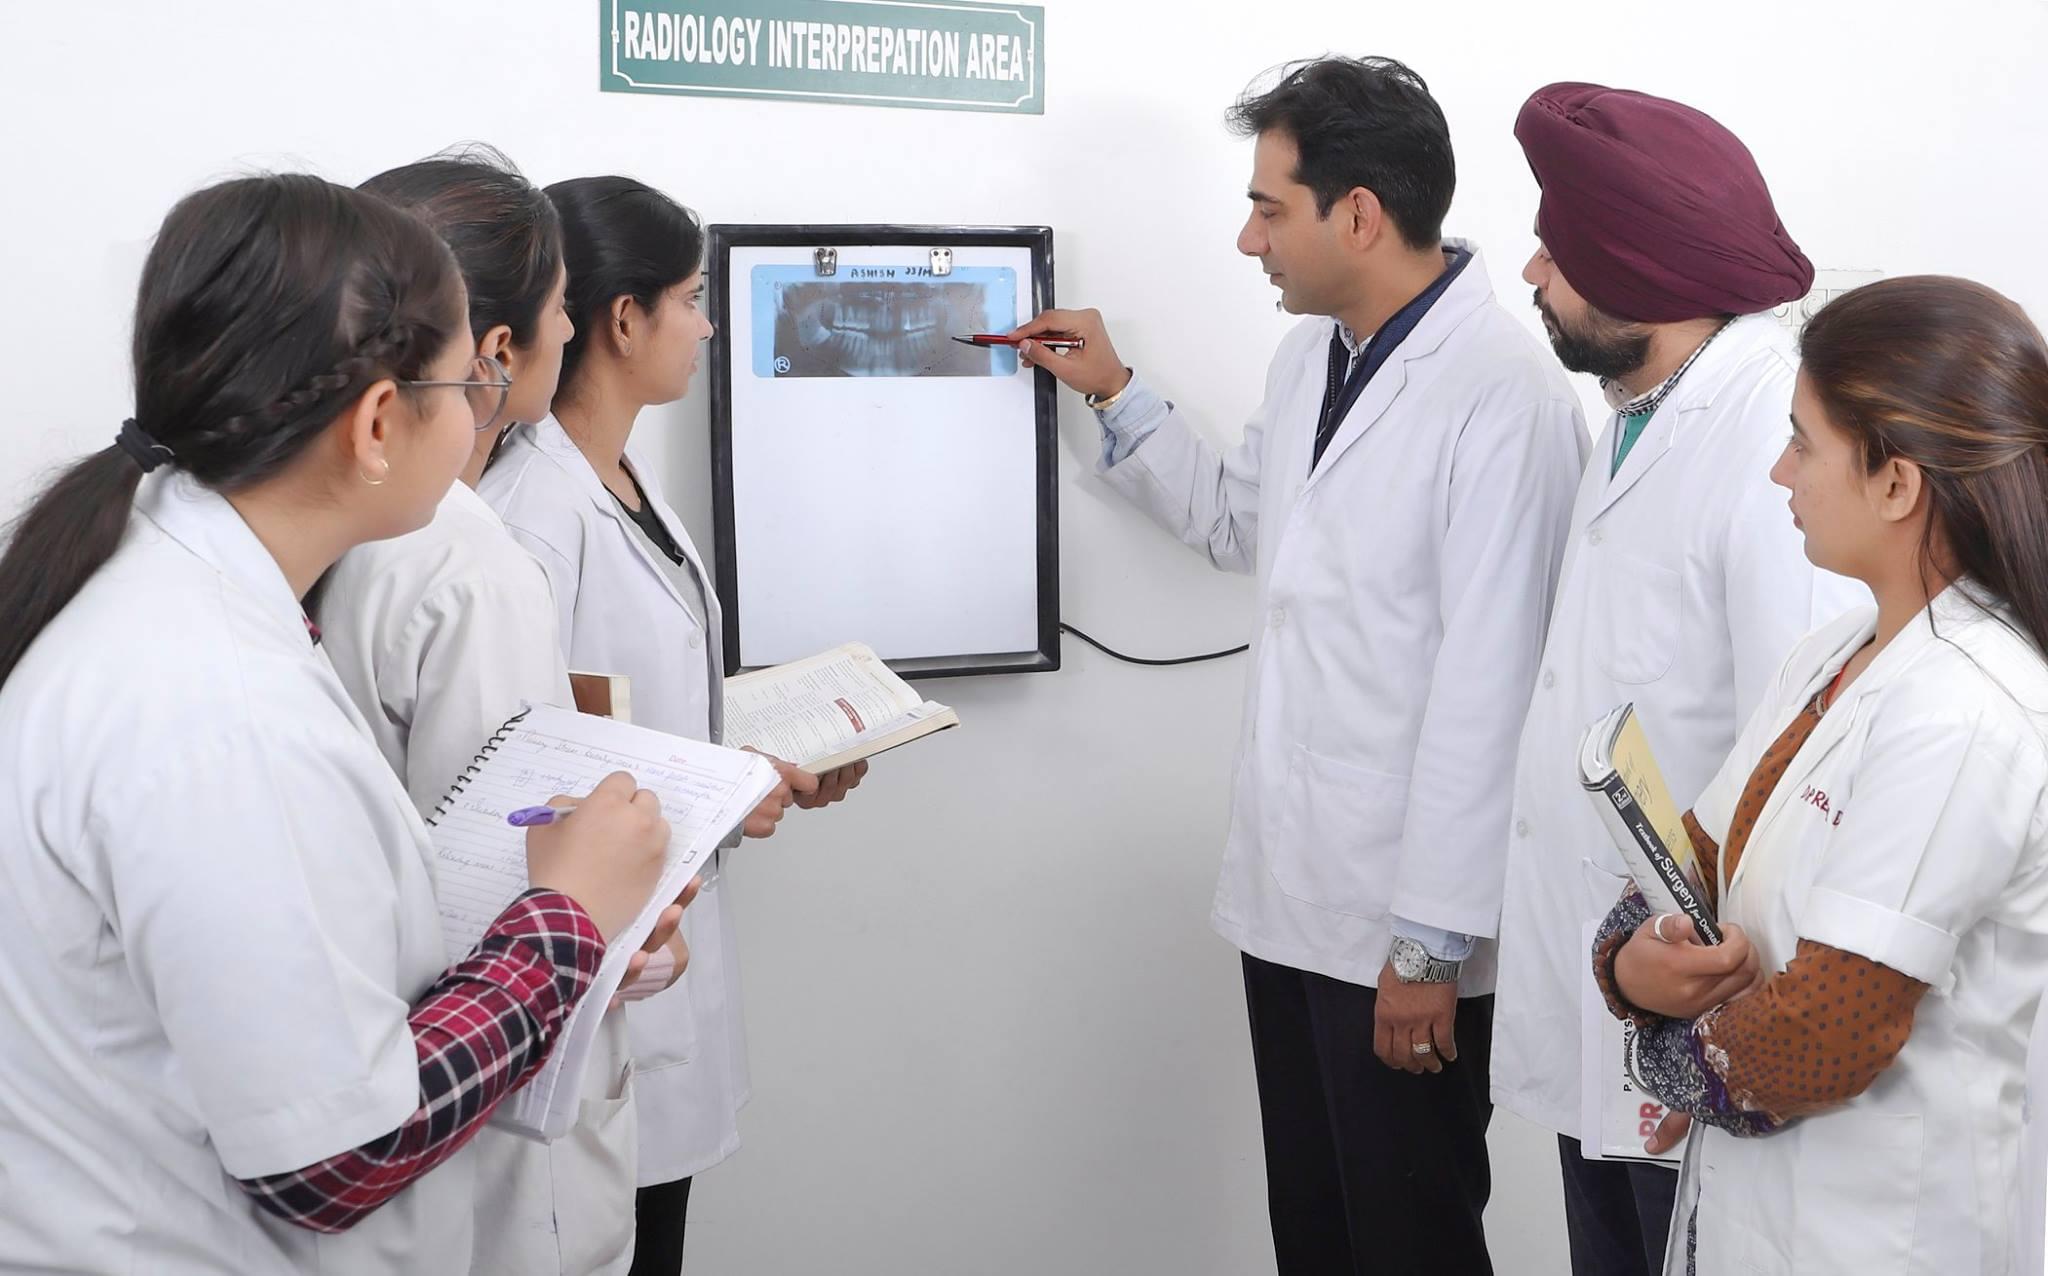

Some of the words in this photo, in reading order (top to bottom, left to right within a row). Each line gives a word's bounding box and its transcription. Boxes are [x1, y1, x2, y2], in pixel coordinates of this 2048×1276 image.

[624, 10, 762, 66] RADIOLOGY
[768, 20, 960, 78] INTERPREPATION
[965, 33, 1024, 82] AREA
[1660, 857, 1697, 909] Surgery
